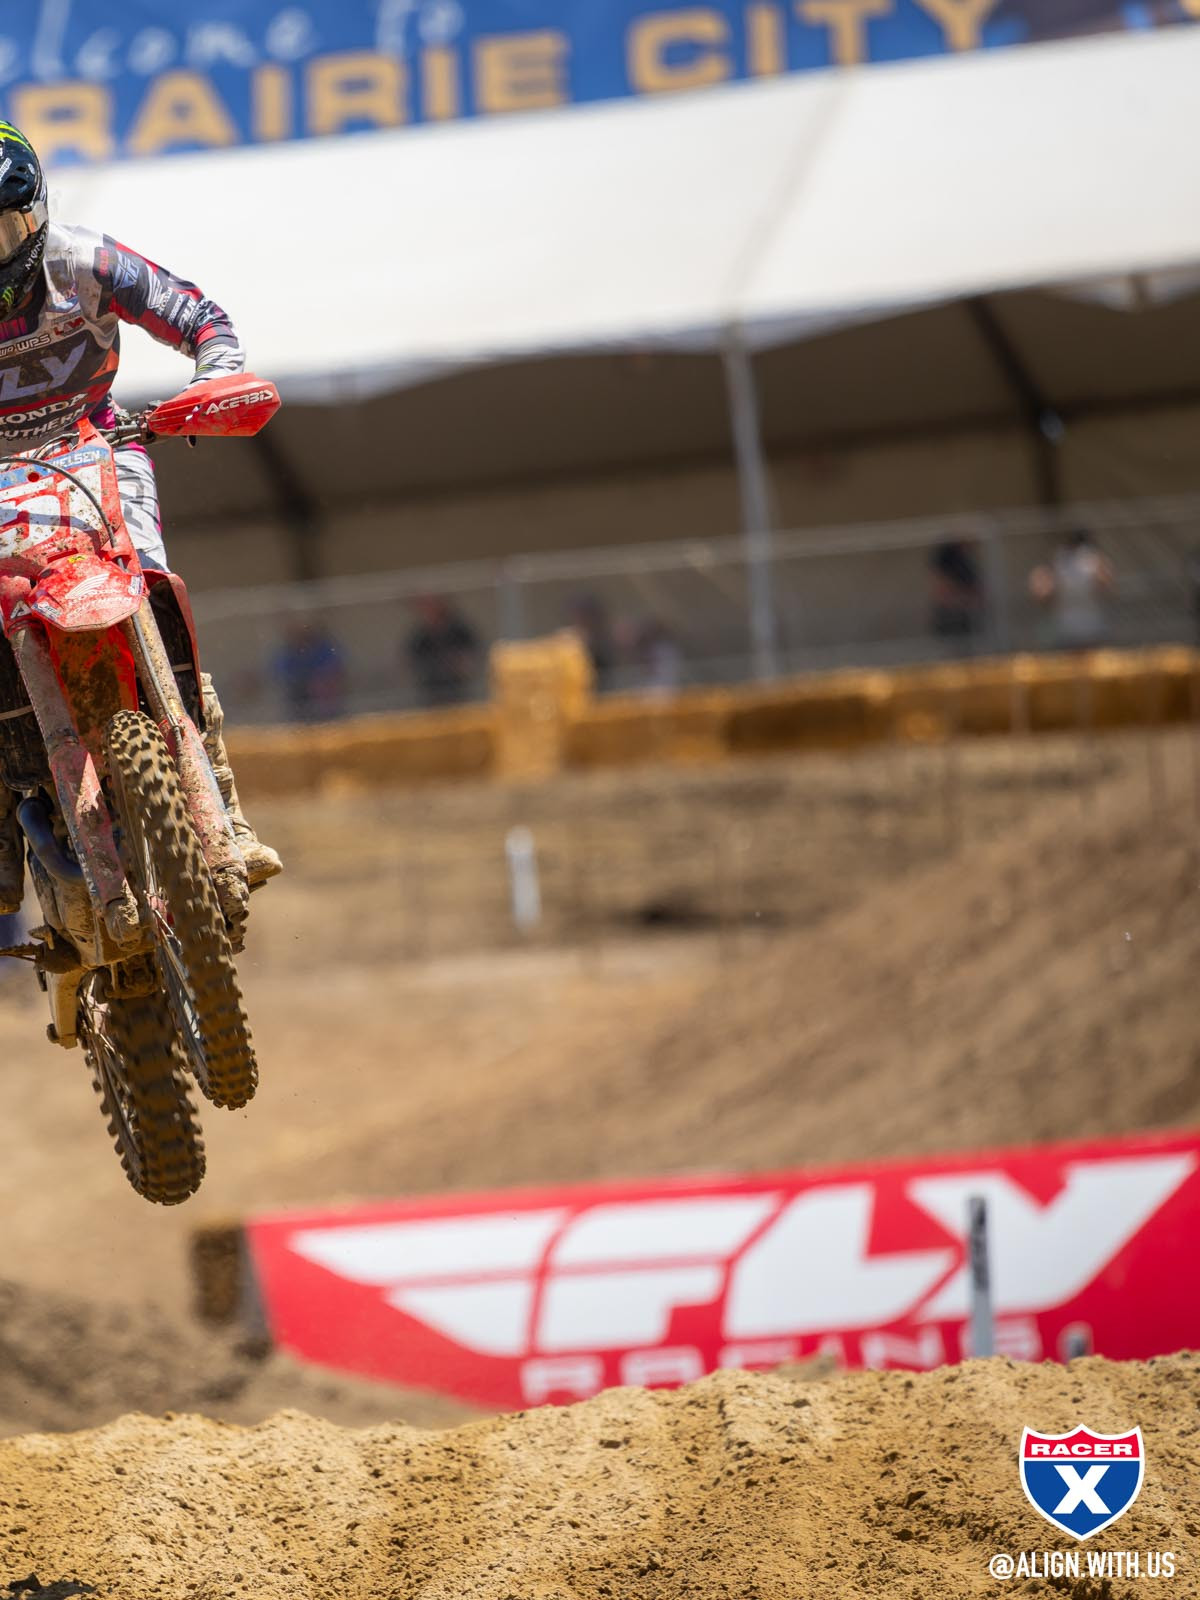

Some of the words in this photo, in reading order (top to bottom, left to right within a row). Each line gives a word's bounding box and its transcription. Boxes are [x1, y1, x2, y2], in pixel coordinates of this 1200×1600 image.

[627, 0, 998, 97] CITY
[17, 334, 50, 351] WPS
[205, 389, 274, 416] ACERBIS
[49, 450, 101, 473] NIELSEN
[532, 1154, 1196, 1357] FLY
